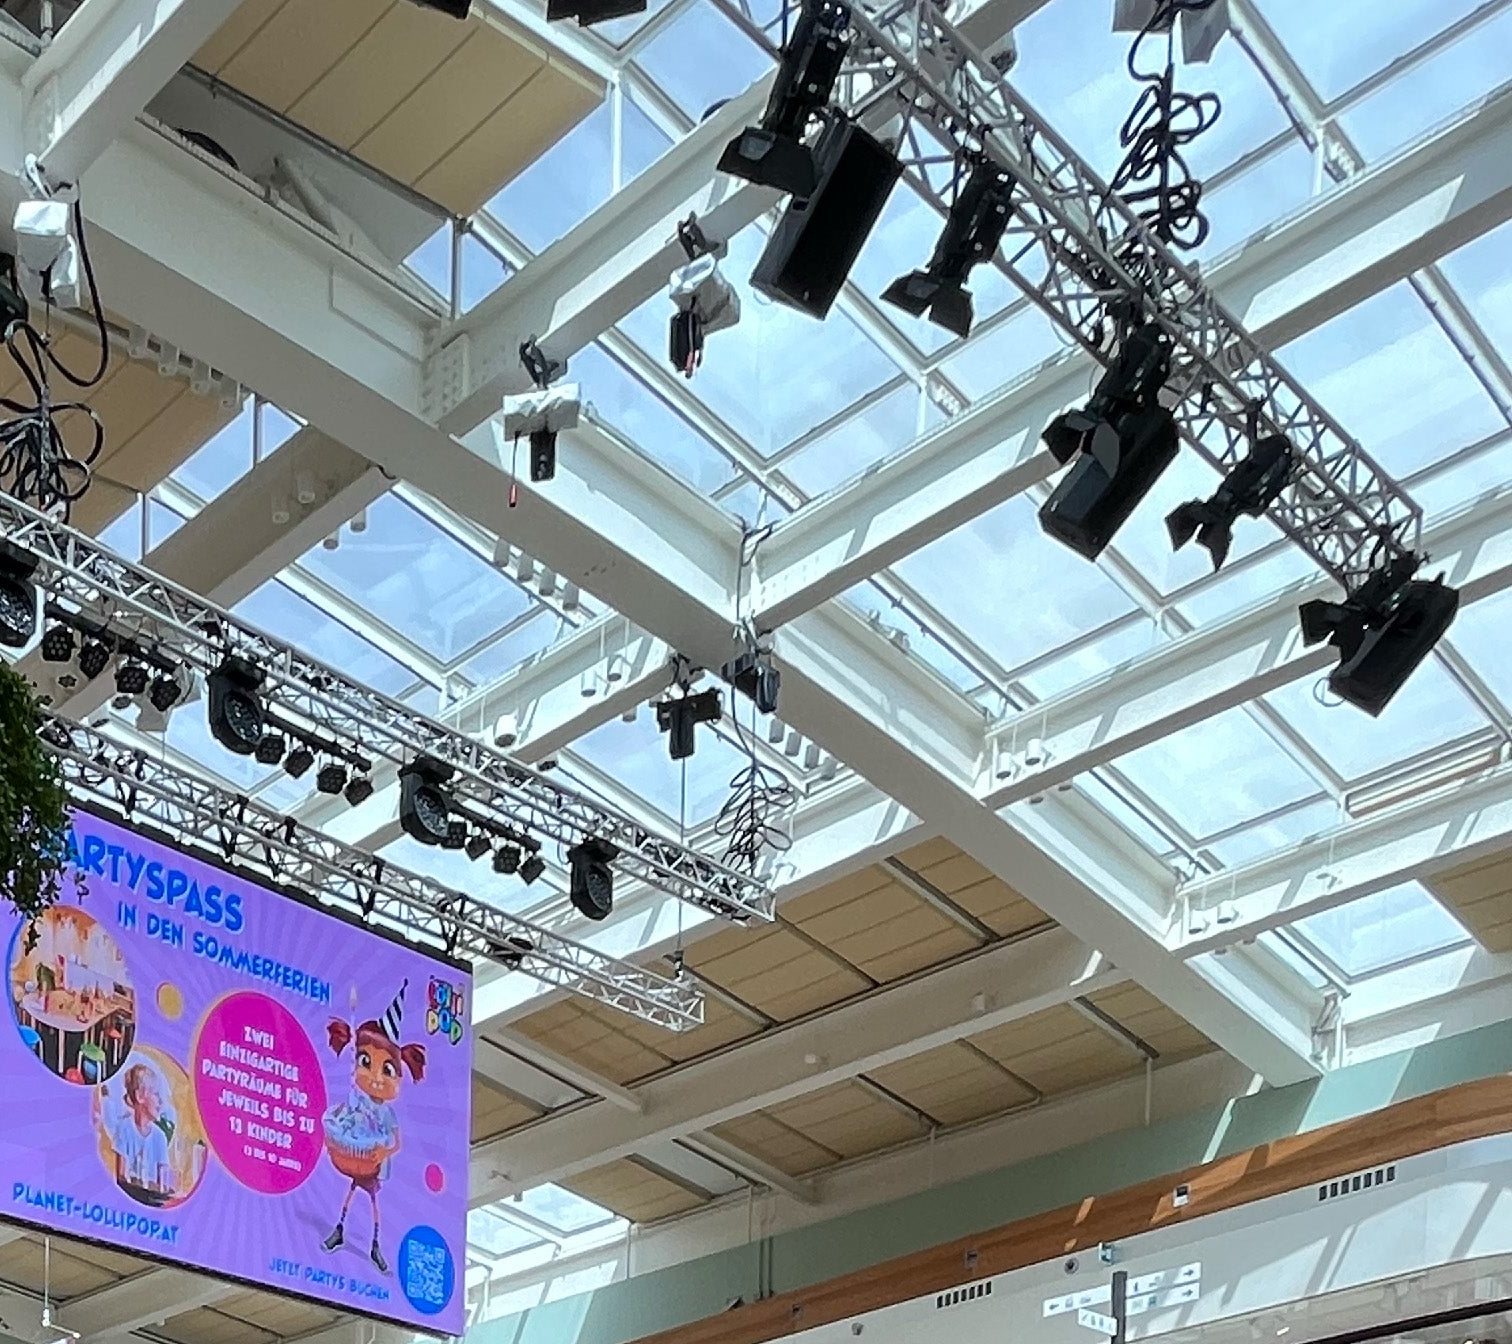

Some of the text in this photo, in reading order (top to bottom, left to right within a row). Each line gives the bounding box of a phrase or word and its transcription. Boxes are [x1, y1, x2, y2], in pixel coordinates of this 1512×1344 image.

[118, 901, 330, 1003] IN DEN SOMMERFERIEN
[244, 1026, 275, 1050] ZWEI
[202, 1058, 282, 1100] PARTYRÄUME
[219, 1040, 300, 1082] EINZIGARTIGE
[218, 1088, 316, 1135] JEWEILS BIS ZU
[247, 1121, 293, 1149] KINDER
[305, 1266, 347, 1291] PARTYS
